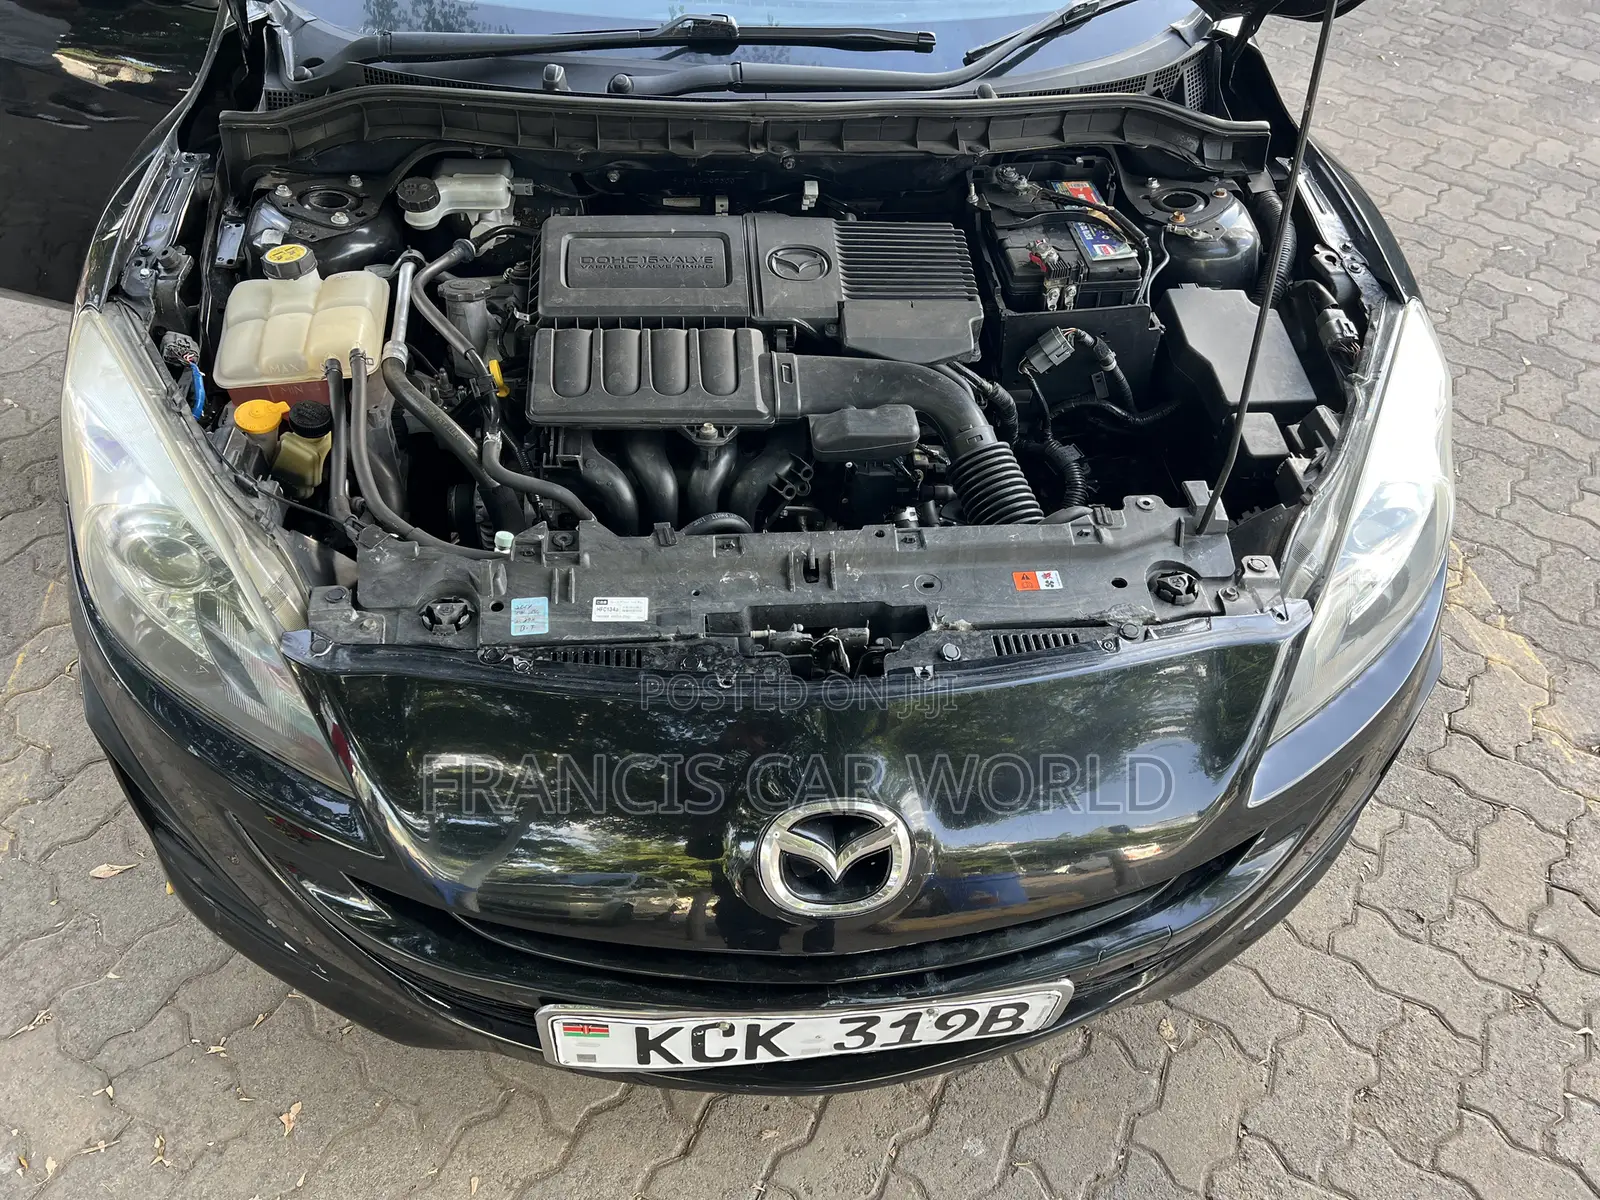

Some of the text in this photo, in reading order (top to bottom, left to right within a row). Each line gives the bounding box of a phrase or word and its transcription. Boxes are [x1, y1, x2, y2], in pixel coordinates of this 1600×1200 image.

[579, 256, 714, 264] DOHC 16-VALVE
[269, 363, 300, 374] MAX
[280, 385, 304, 395] MIN
[636, 1001, 1031, 1065] KCK 319B
